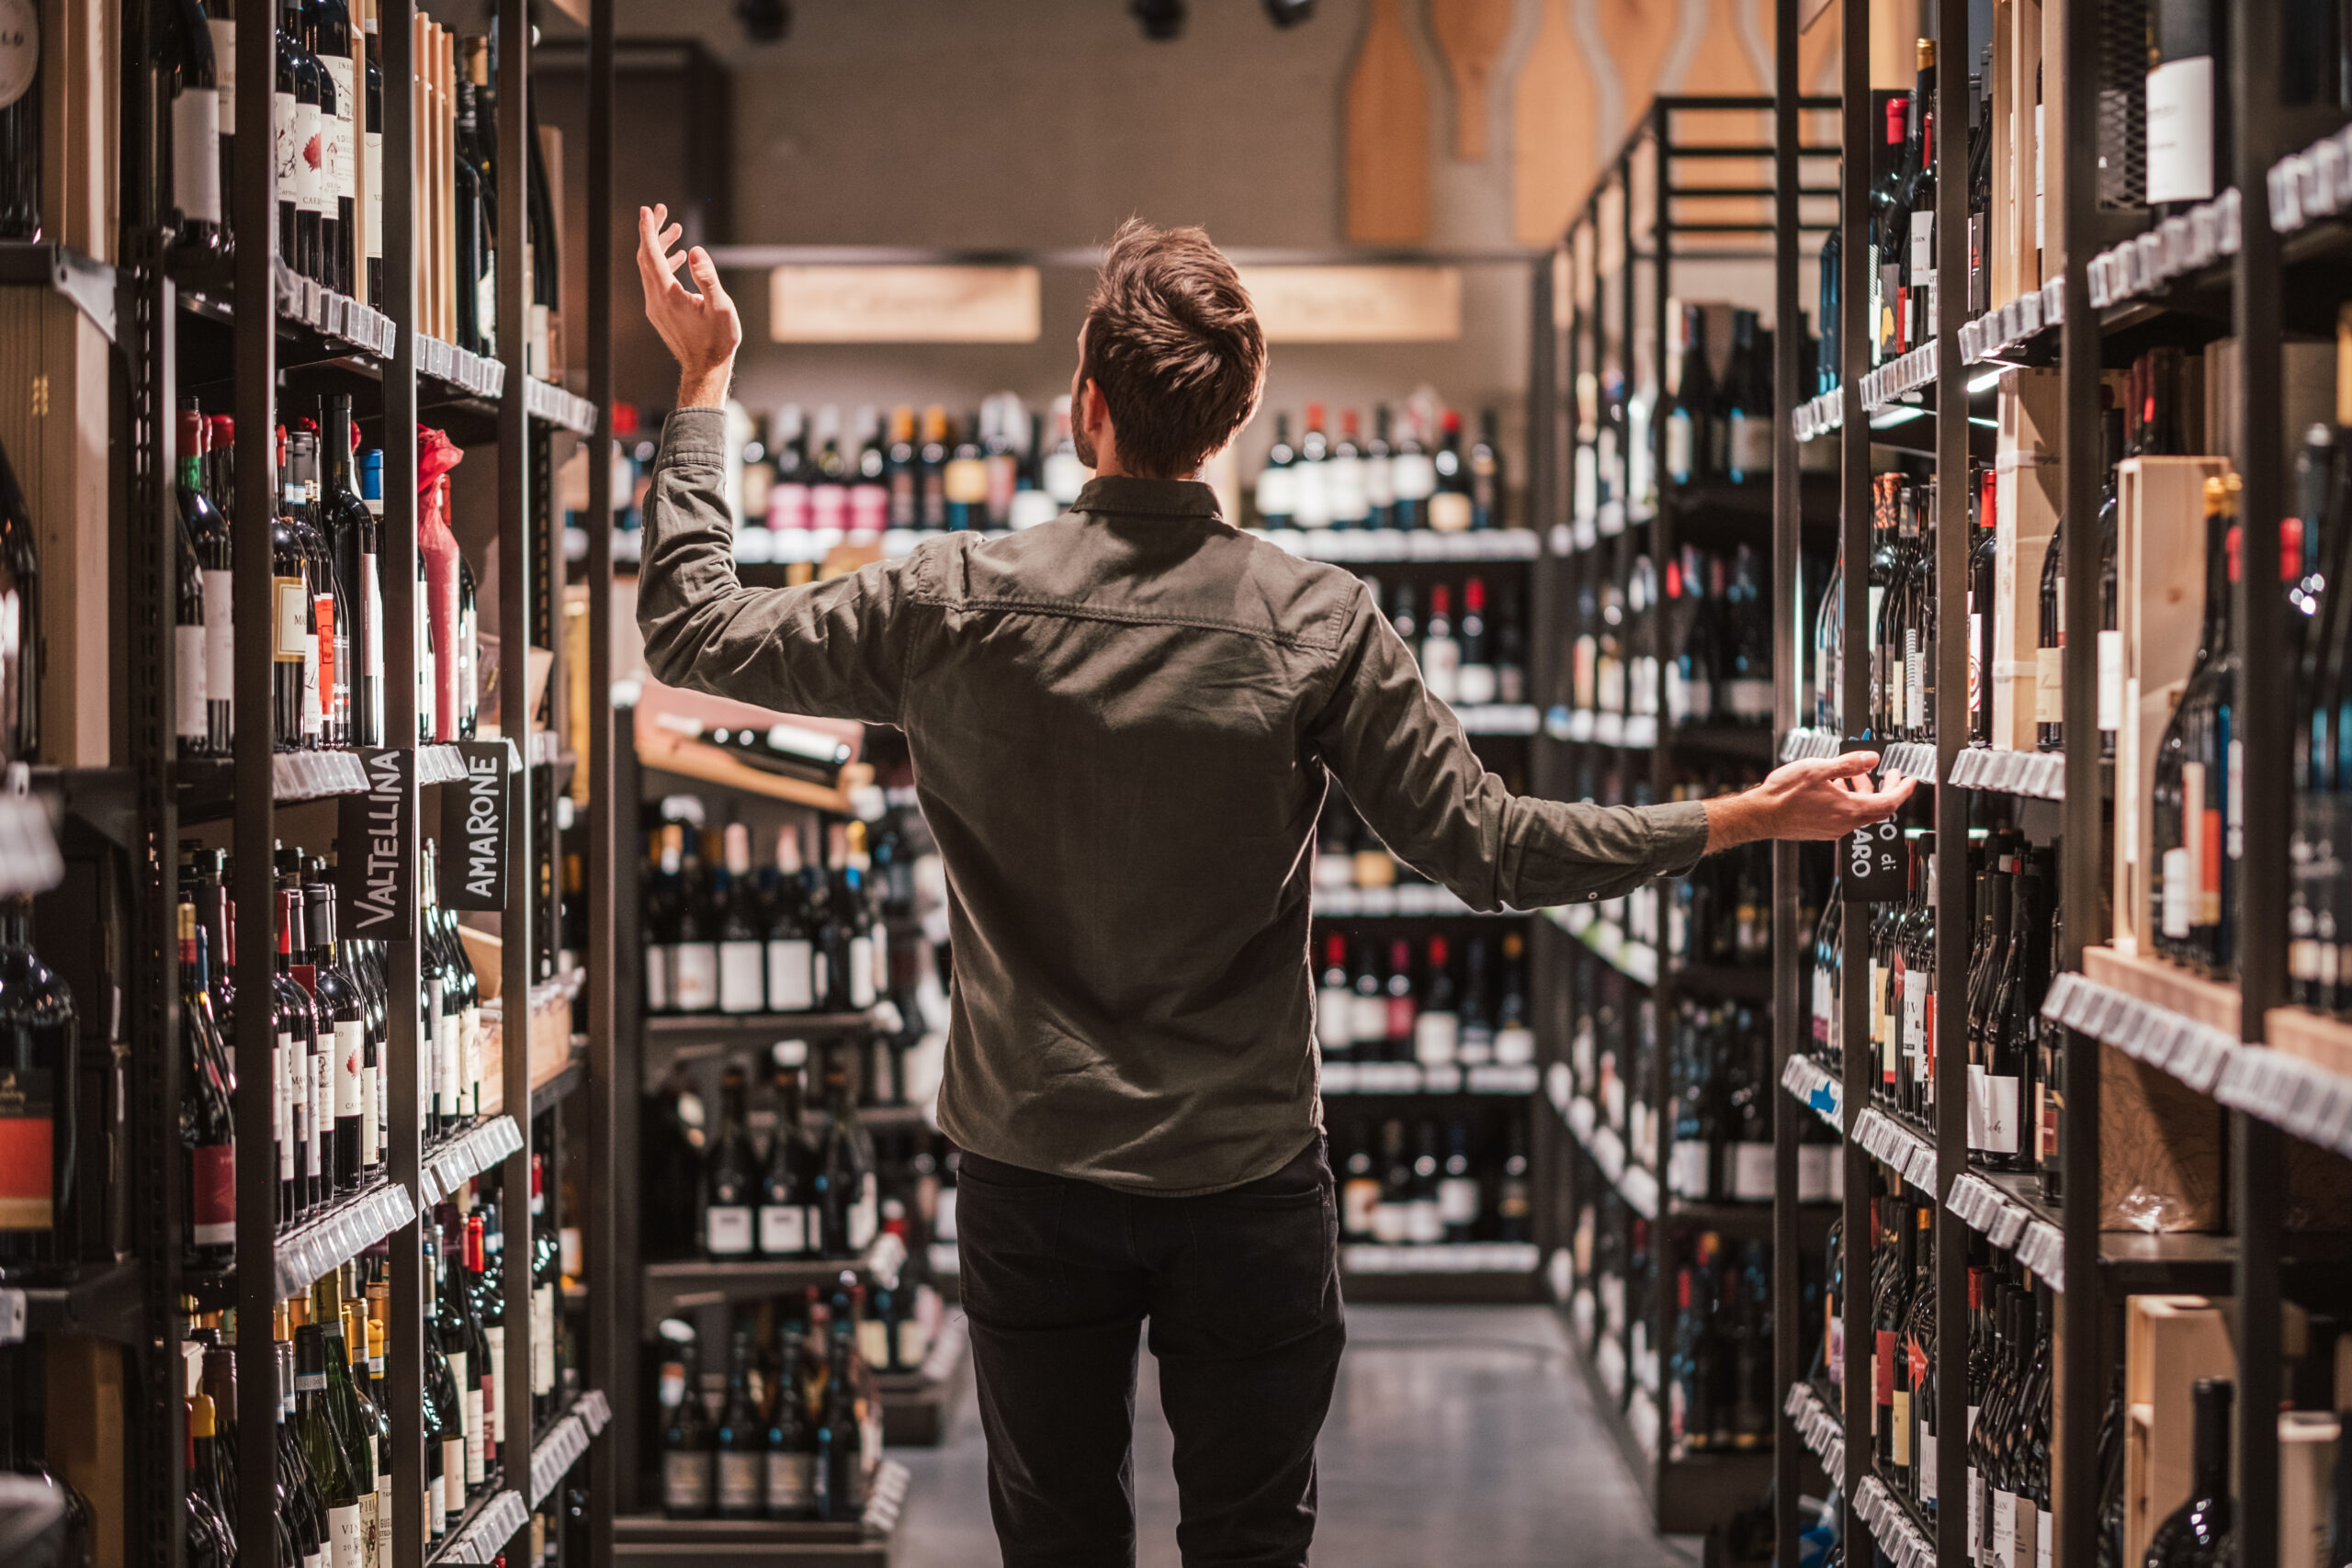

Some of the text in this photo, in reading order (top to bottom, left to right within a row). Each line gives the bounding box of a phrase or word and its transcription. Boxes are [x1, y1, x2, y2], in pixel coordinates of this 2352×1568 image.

[354, 750, 402, 929] VALTELLINA
[466, 756, 499, 897] AMARONE
[1851, 824, 1873, 878] ARO
[1881, 853, 1897, 871] di
